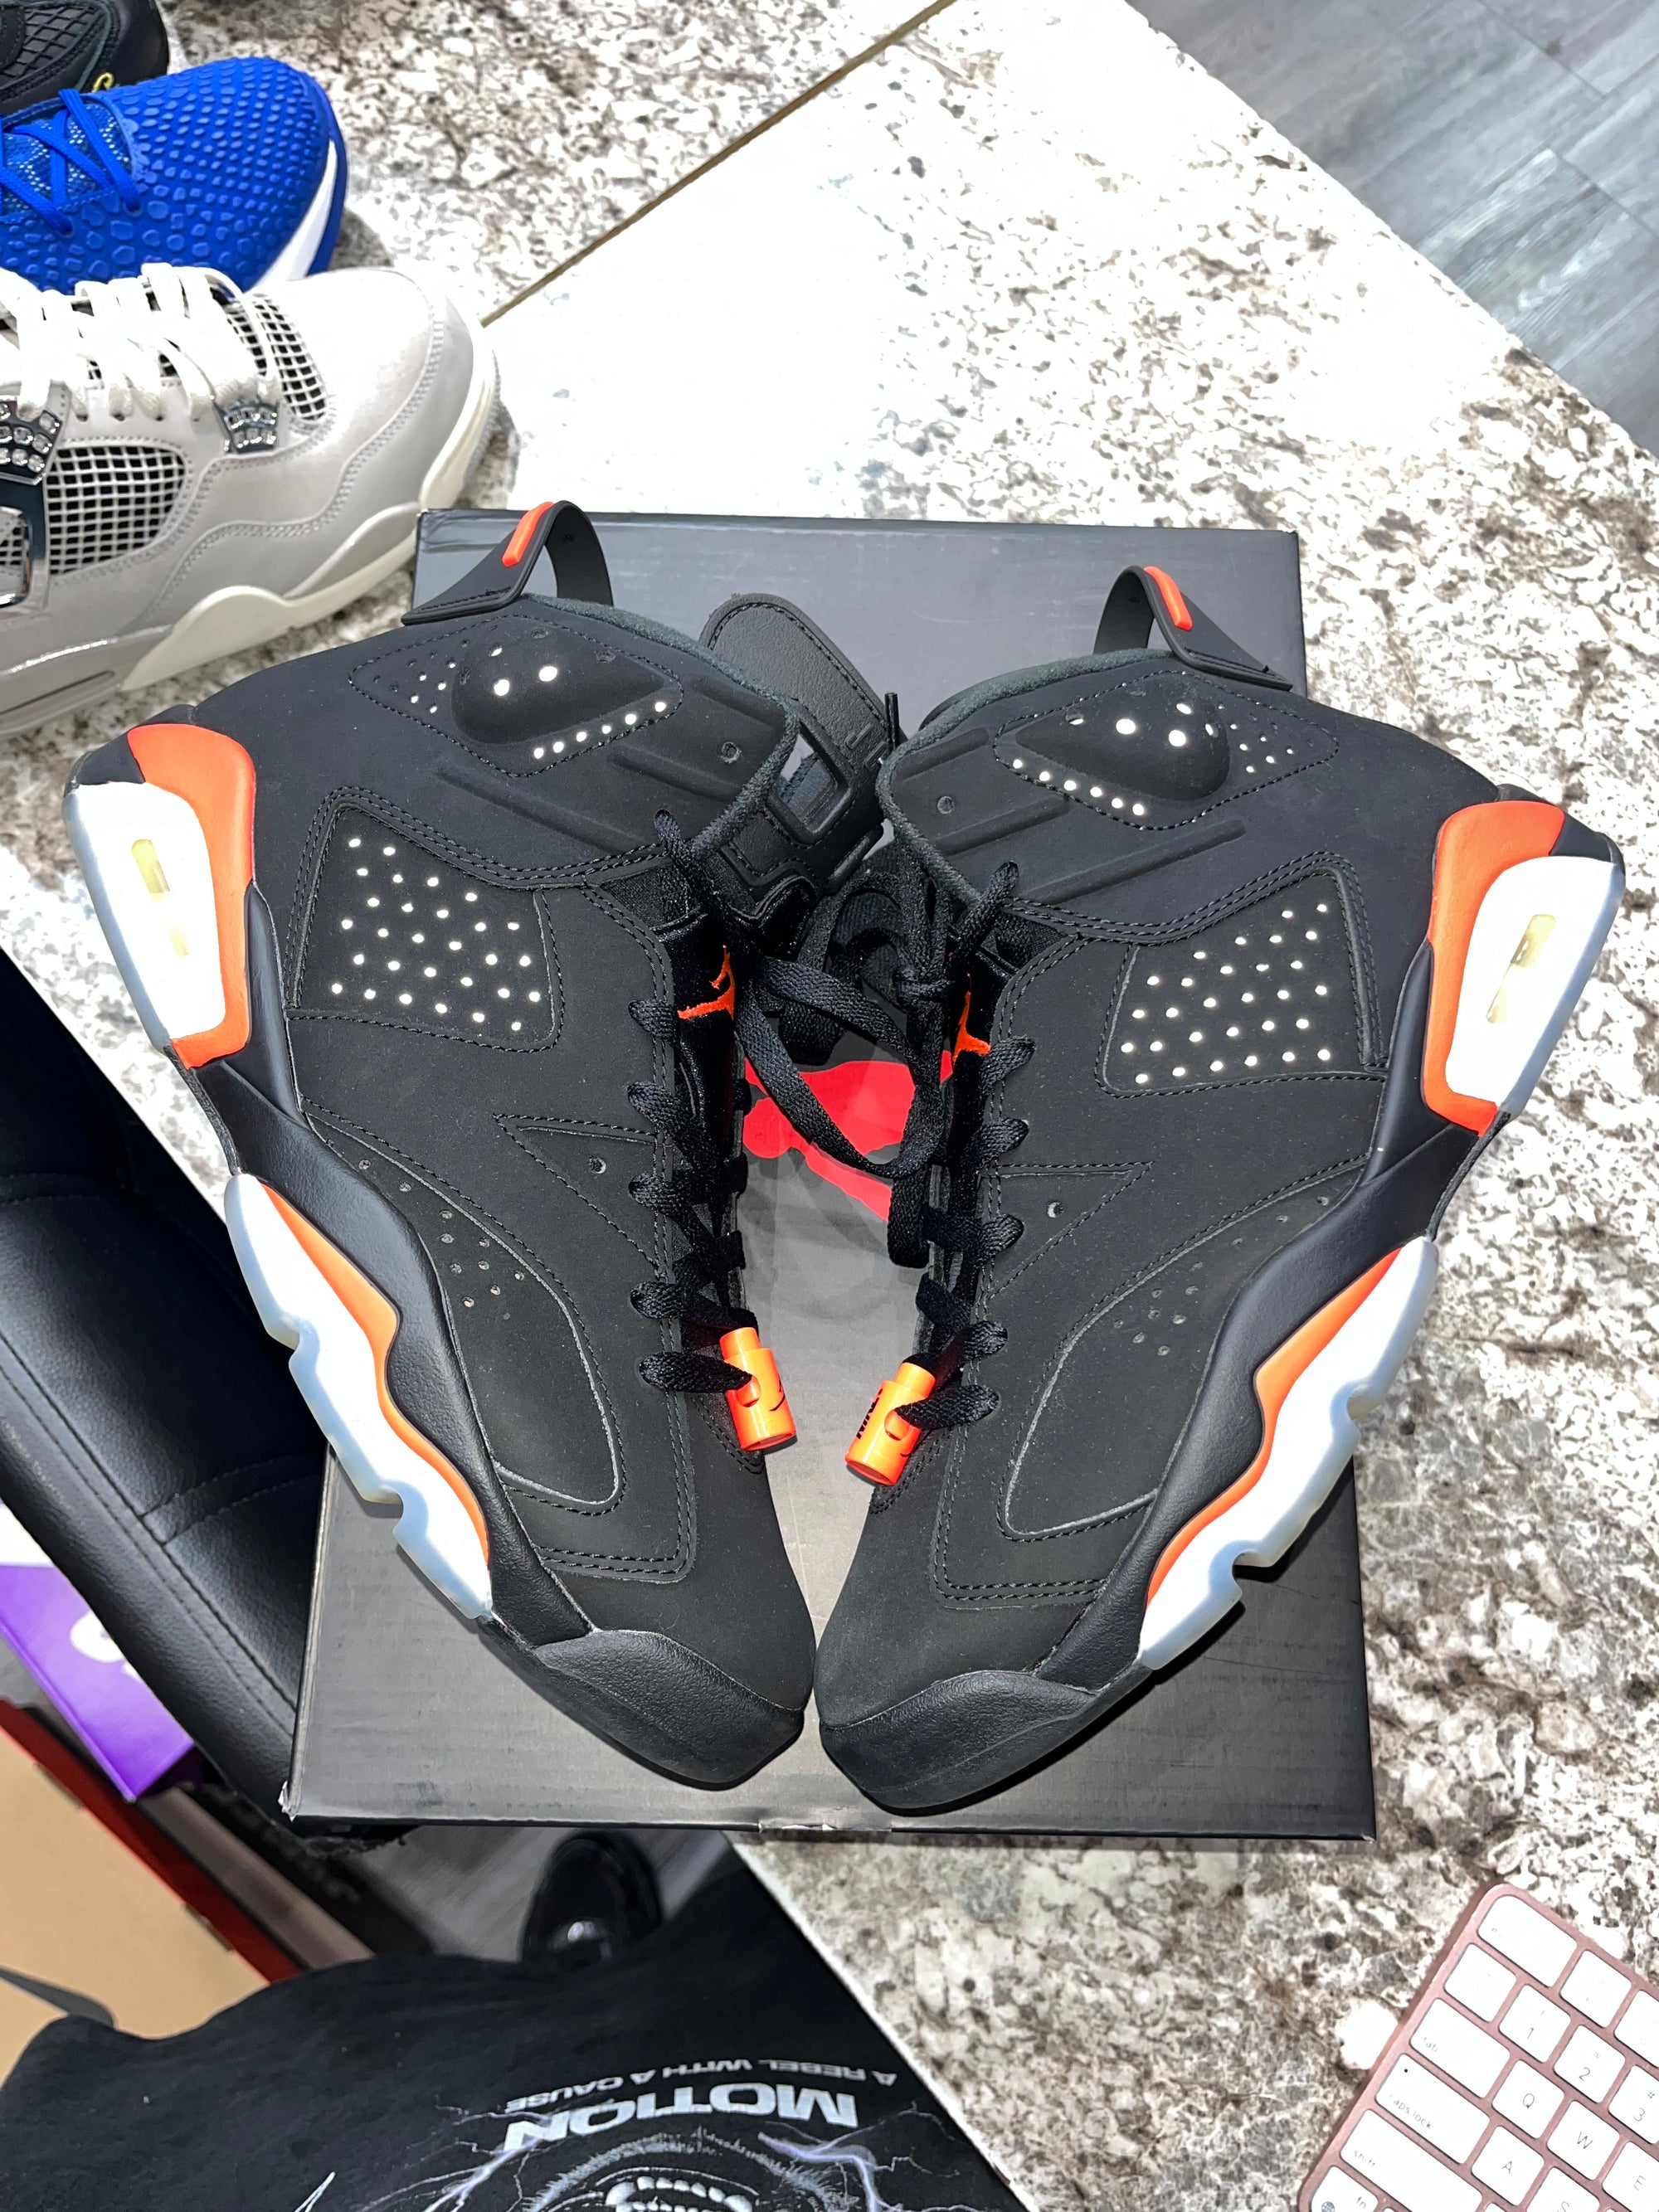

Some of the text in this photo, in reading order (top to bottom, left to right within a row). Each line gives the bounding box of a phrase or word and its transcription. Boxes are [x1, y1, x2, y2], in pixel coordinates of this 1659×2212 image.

[1526, 2027, 1535, 2039] 1
[1579, 2066, 1591, 2082] 2
[504, 2059, 898, 2114] A REBEL WITH A CAUSE
[1522, 2093, 1535, 2109] Q
[503, 2082, 859, 2152] MOTION
[1633, 2107, 1646, 2122] 3
[1576, 2131, 1594, 2150] W
[1501, 2160, 1513, 2176] A
[1632, 2175, 1647, 2192] E
[1355, 2195, 1367, 2210] fn
[1557, 2200, 1570, 2212] S
